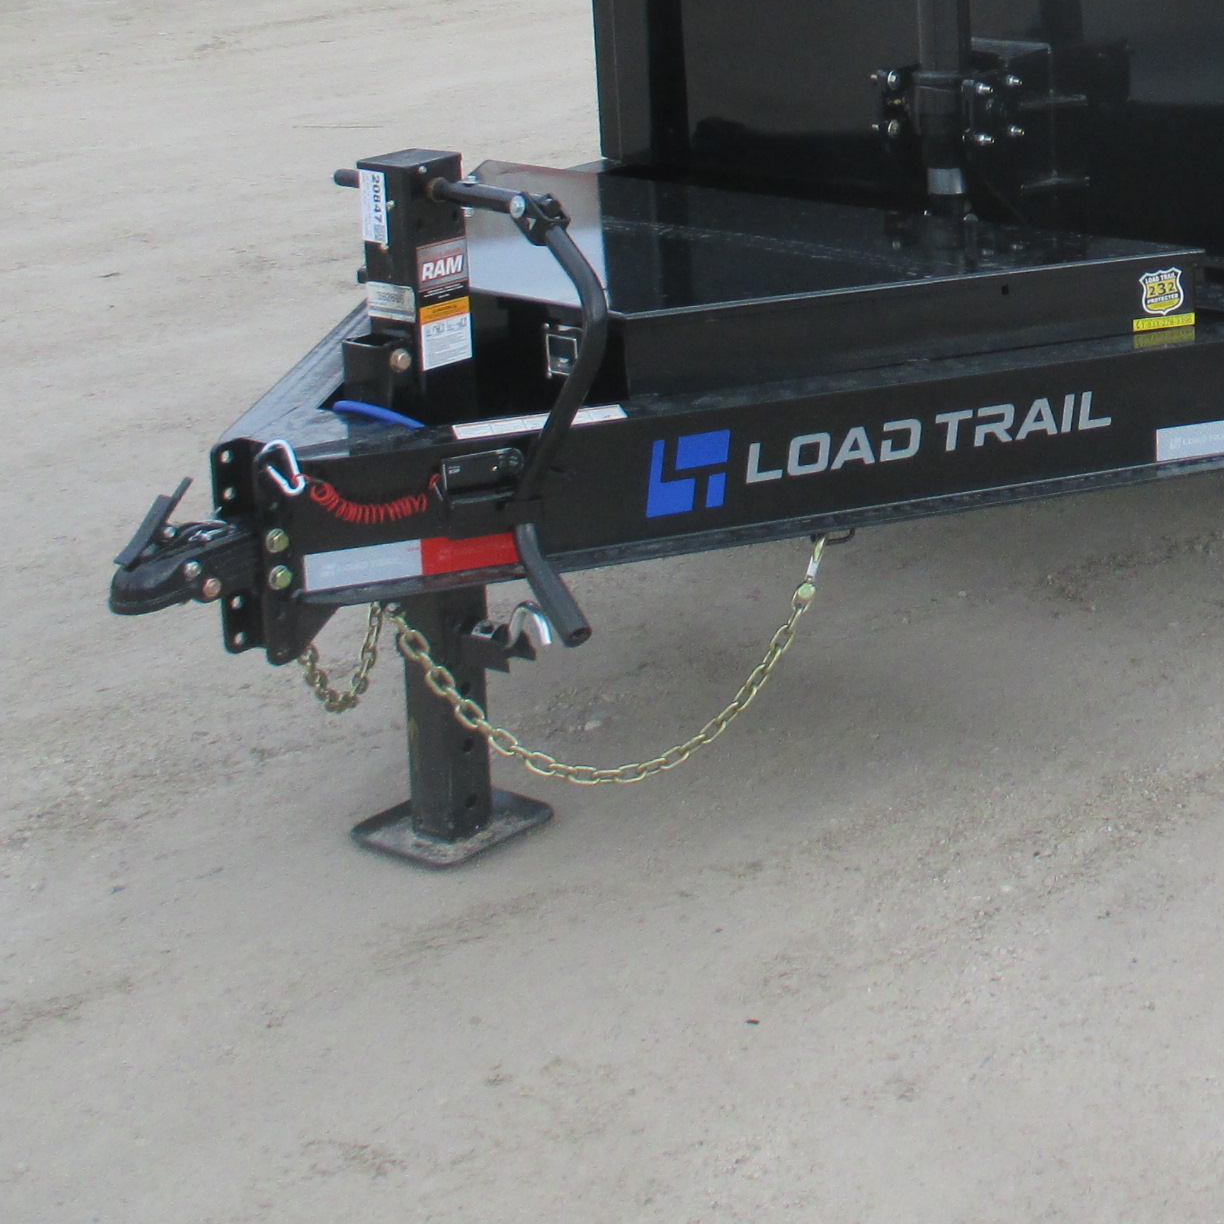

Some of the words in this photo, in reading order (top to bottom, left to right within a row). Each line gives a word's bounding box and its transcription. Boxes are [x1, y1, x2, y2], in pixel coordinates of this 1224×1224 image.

[372, 174, 383, 223] 20847
[421, 254, 464, 281] RAM
[1145, 276, 1160, 284] LOAD
[1149, 282, 1175, 295] 232
[1147, 293, 1179, 304] PROTECTED
[745, 418, 922, 484] LOAD
[935, 391, 1112, 452] TRAIL
